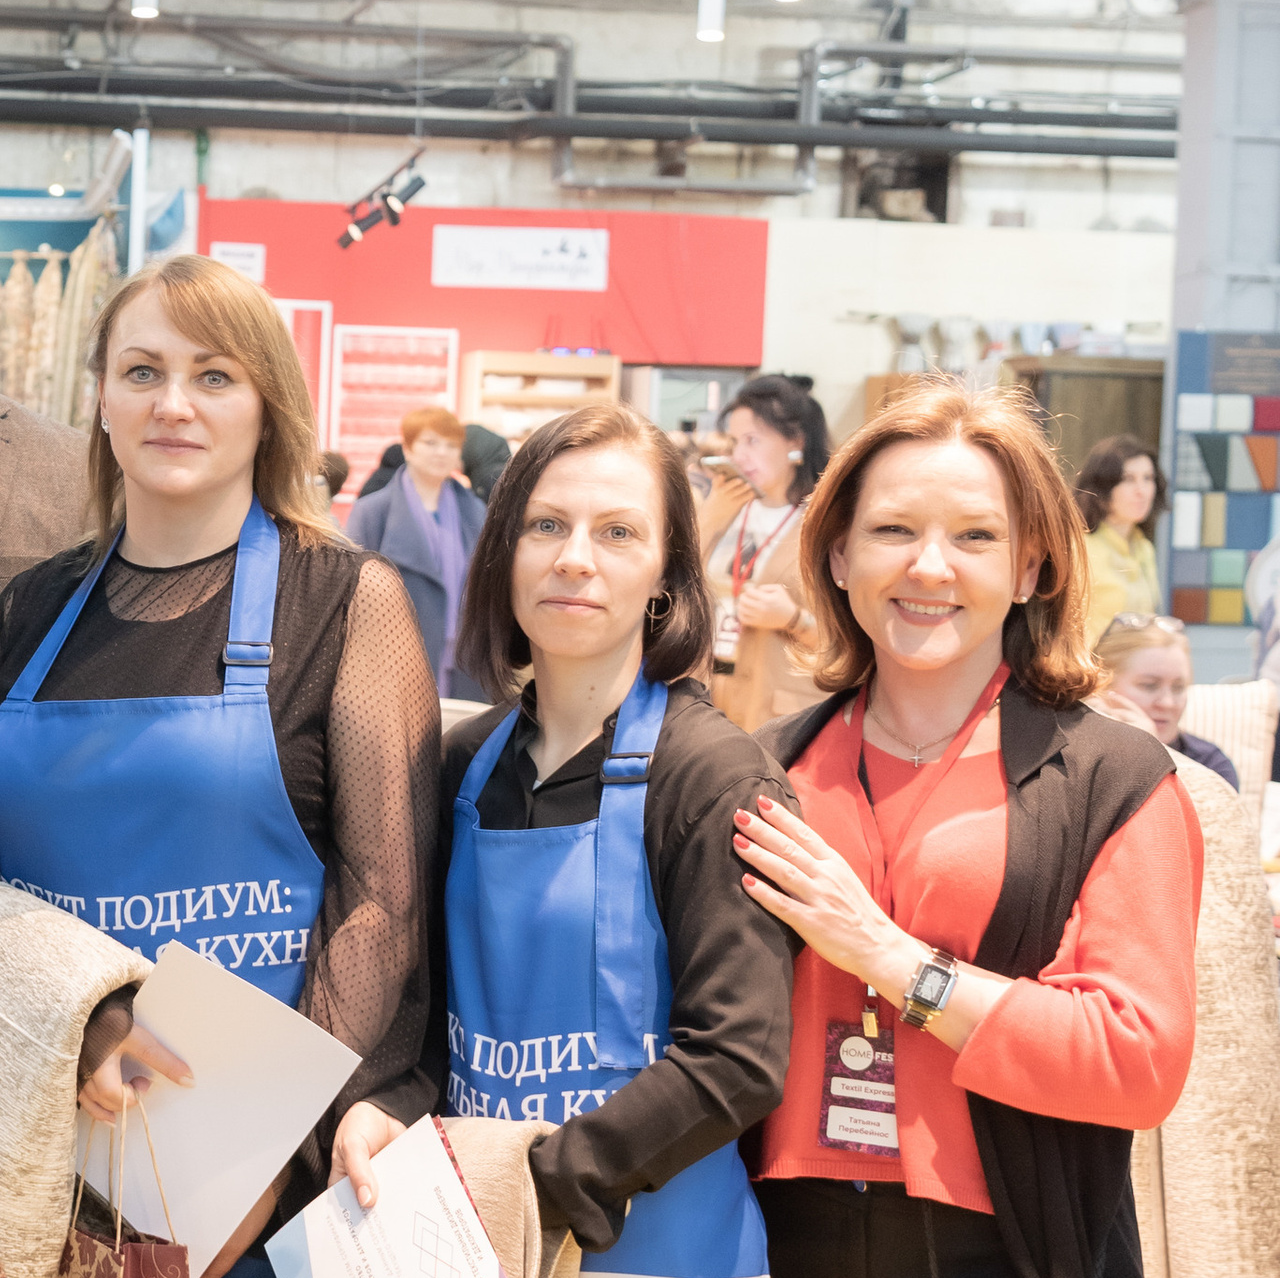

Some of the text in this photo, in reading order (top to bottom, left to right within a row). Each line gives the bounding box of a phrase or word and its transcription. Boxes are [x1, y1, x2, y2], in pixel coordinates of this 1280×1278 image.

[96, 879, 293, 936] ПОДИУМ:
[841, 1047, 872, 1060] HOME
[840, 1082, 863, 1093] Textil
[848, 1116, 881, 1128] Татьяна
[838, 1124, 889, 1139] Перебейнос
